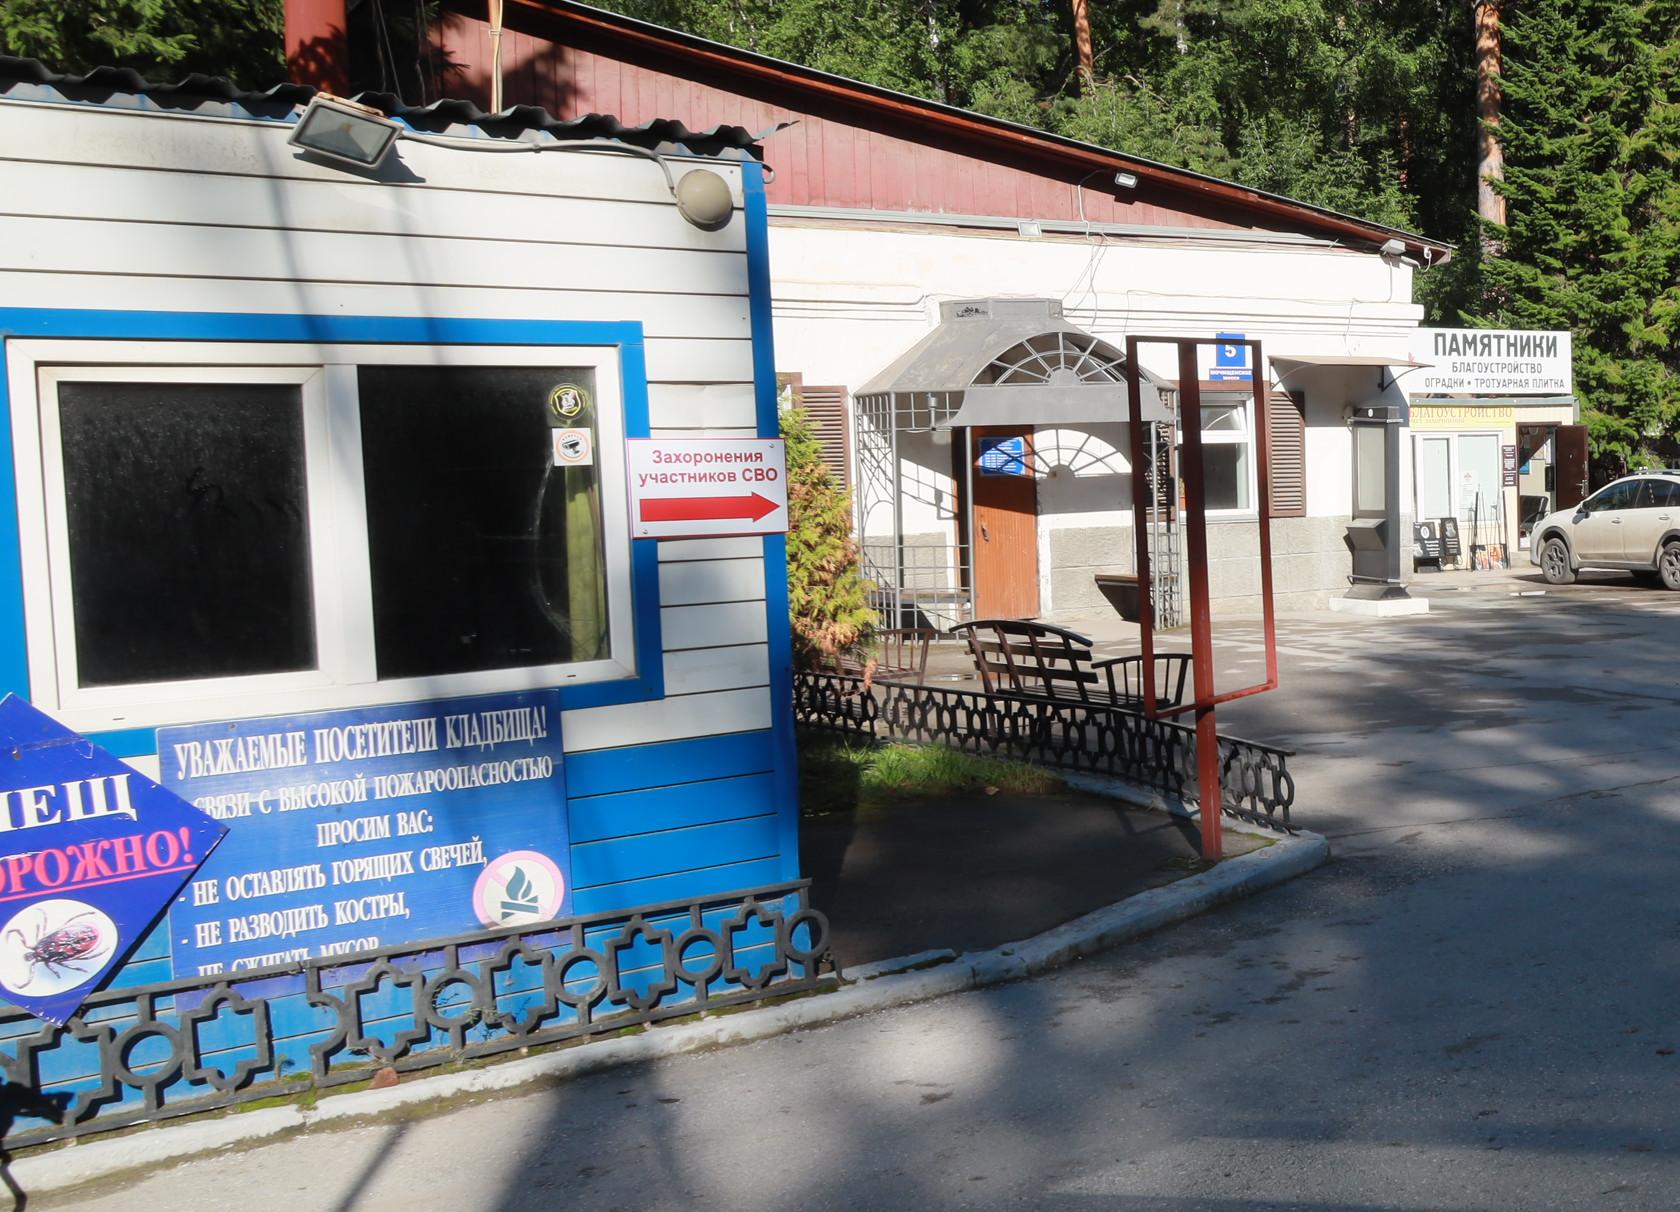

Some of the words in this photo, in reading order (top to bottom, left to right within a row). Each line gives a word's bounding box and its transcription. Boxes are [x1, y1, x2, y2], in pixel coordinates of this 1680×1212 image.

[1224, 344, 1237, 357] 5
[1434, 333, 1557, 358] ПАМЯТНИКИ
[1424, 378, 1464, 389] ОГРАДКИ
[1475, 378, 1529, 389] ТРОТУАРНАЯ
[1532, 379, 1565, 389] ПЛИТКА
[1452, 362, 1542, 374] БЛАГОУСТРОЙСТВО
[638, 471, 737, 487] участников
[741, 467, 778, 482] СВО
[652, 450, 763, 466] Захоронения
[173, 731, 308, 781] УВАЖАЕМЫЕ
[313, 717, 439, 764] ПОСЕТИТЕЛИ
[444, 705, 548, 752] КЛАДБИЩА!
[0, 773, 138, 832] ЕЩ
[258, 789, 272, 814] С
[278, 772, 369, 812] ВЫСОКОЙ
[374, 755, 553, 800] ПОЖАРООПАСНОСТЬЮ
[316, 815, 391, 847] ПРОСИМ
[396, 809, 434, 837] ВАС:
[0, 826, 194, 893] РОЖНО!
[192, 880, 220, 907] НЕ
[225, 864, 326, 901] ОСТАВЛЯТЬ
[332, 851, 415, 885] ГОРЯЩИХ
[419, 835, 488, 872] СВЕЧЕЙ,
[194, 921, 222, 949] НЕ
[228, 904, 329, 943] РАЗВОДИТЬ
[334, 892, 410, 926] КОСТРЫ,
